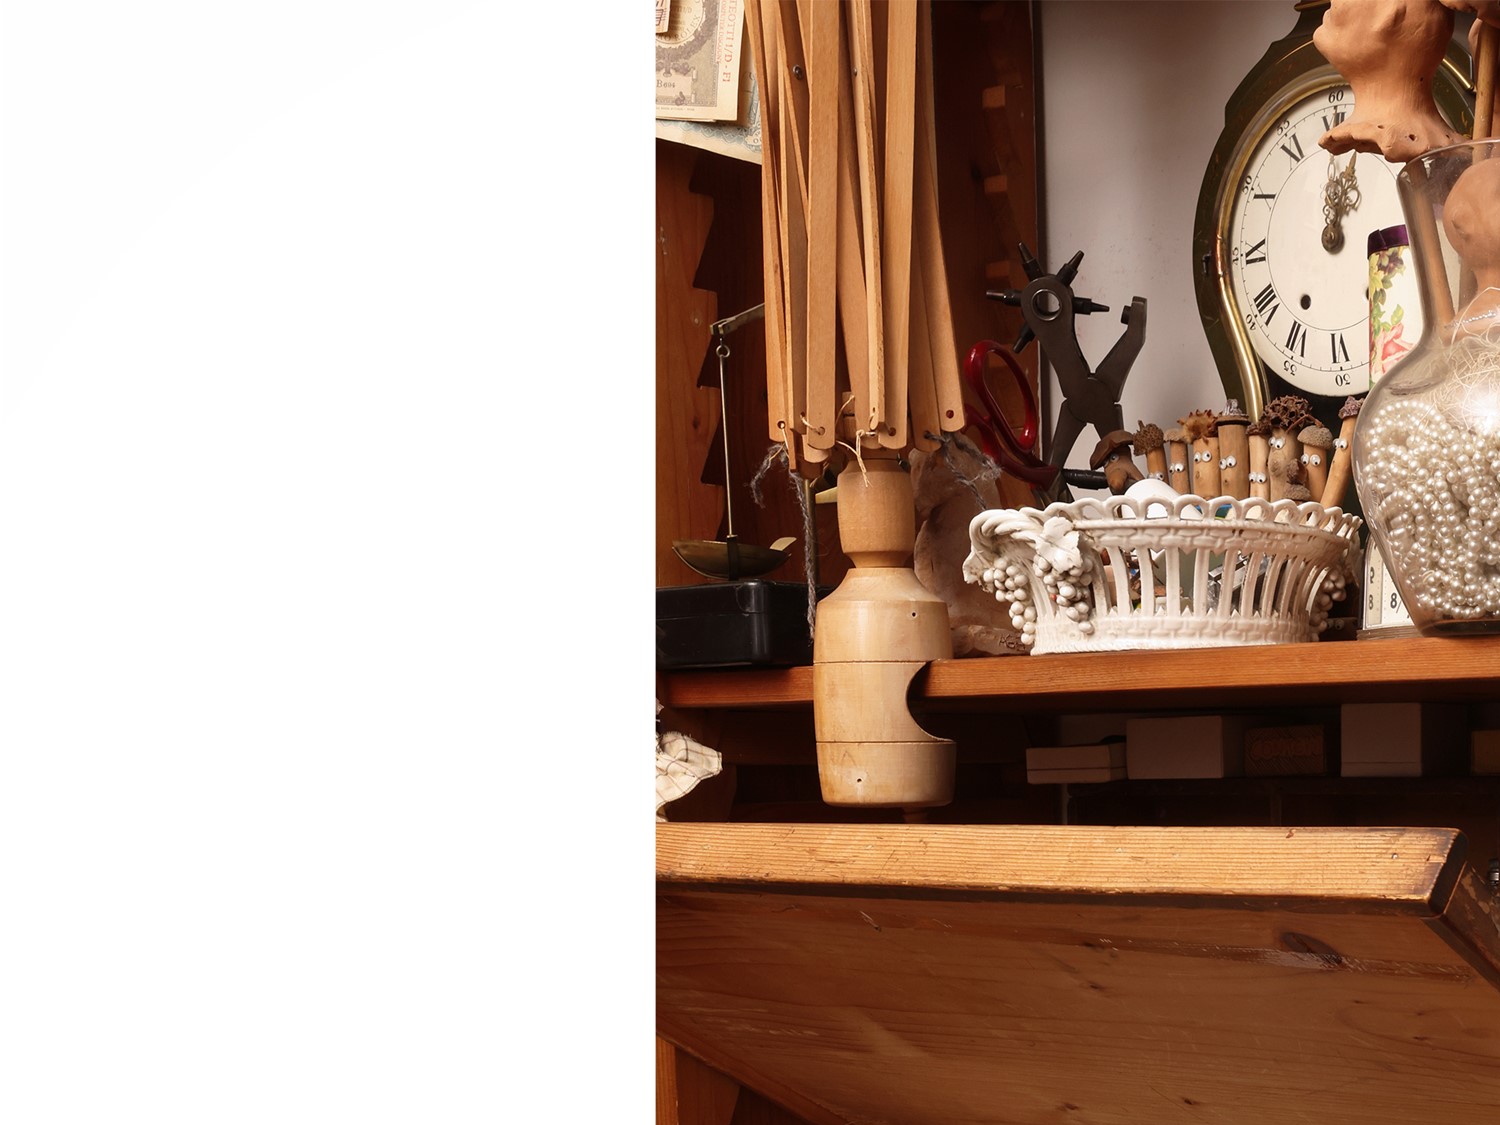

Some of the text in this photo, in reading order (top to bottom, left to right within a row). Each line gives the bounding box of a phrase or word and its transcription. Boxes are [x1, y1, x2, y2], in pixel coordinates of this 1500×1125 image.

[1328, 89, 1344, 103] 60
[1276, 119, 1290, 136] 55
[1241, 175, 1252, 195] 50
[1253, 283, 1281, 327] VIII
[1285, 320, 1308, 358] VII
[1330, 333, 1350, 364] VI
[1335, 373, 1351, 387] 30
